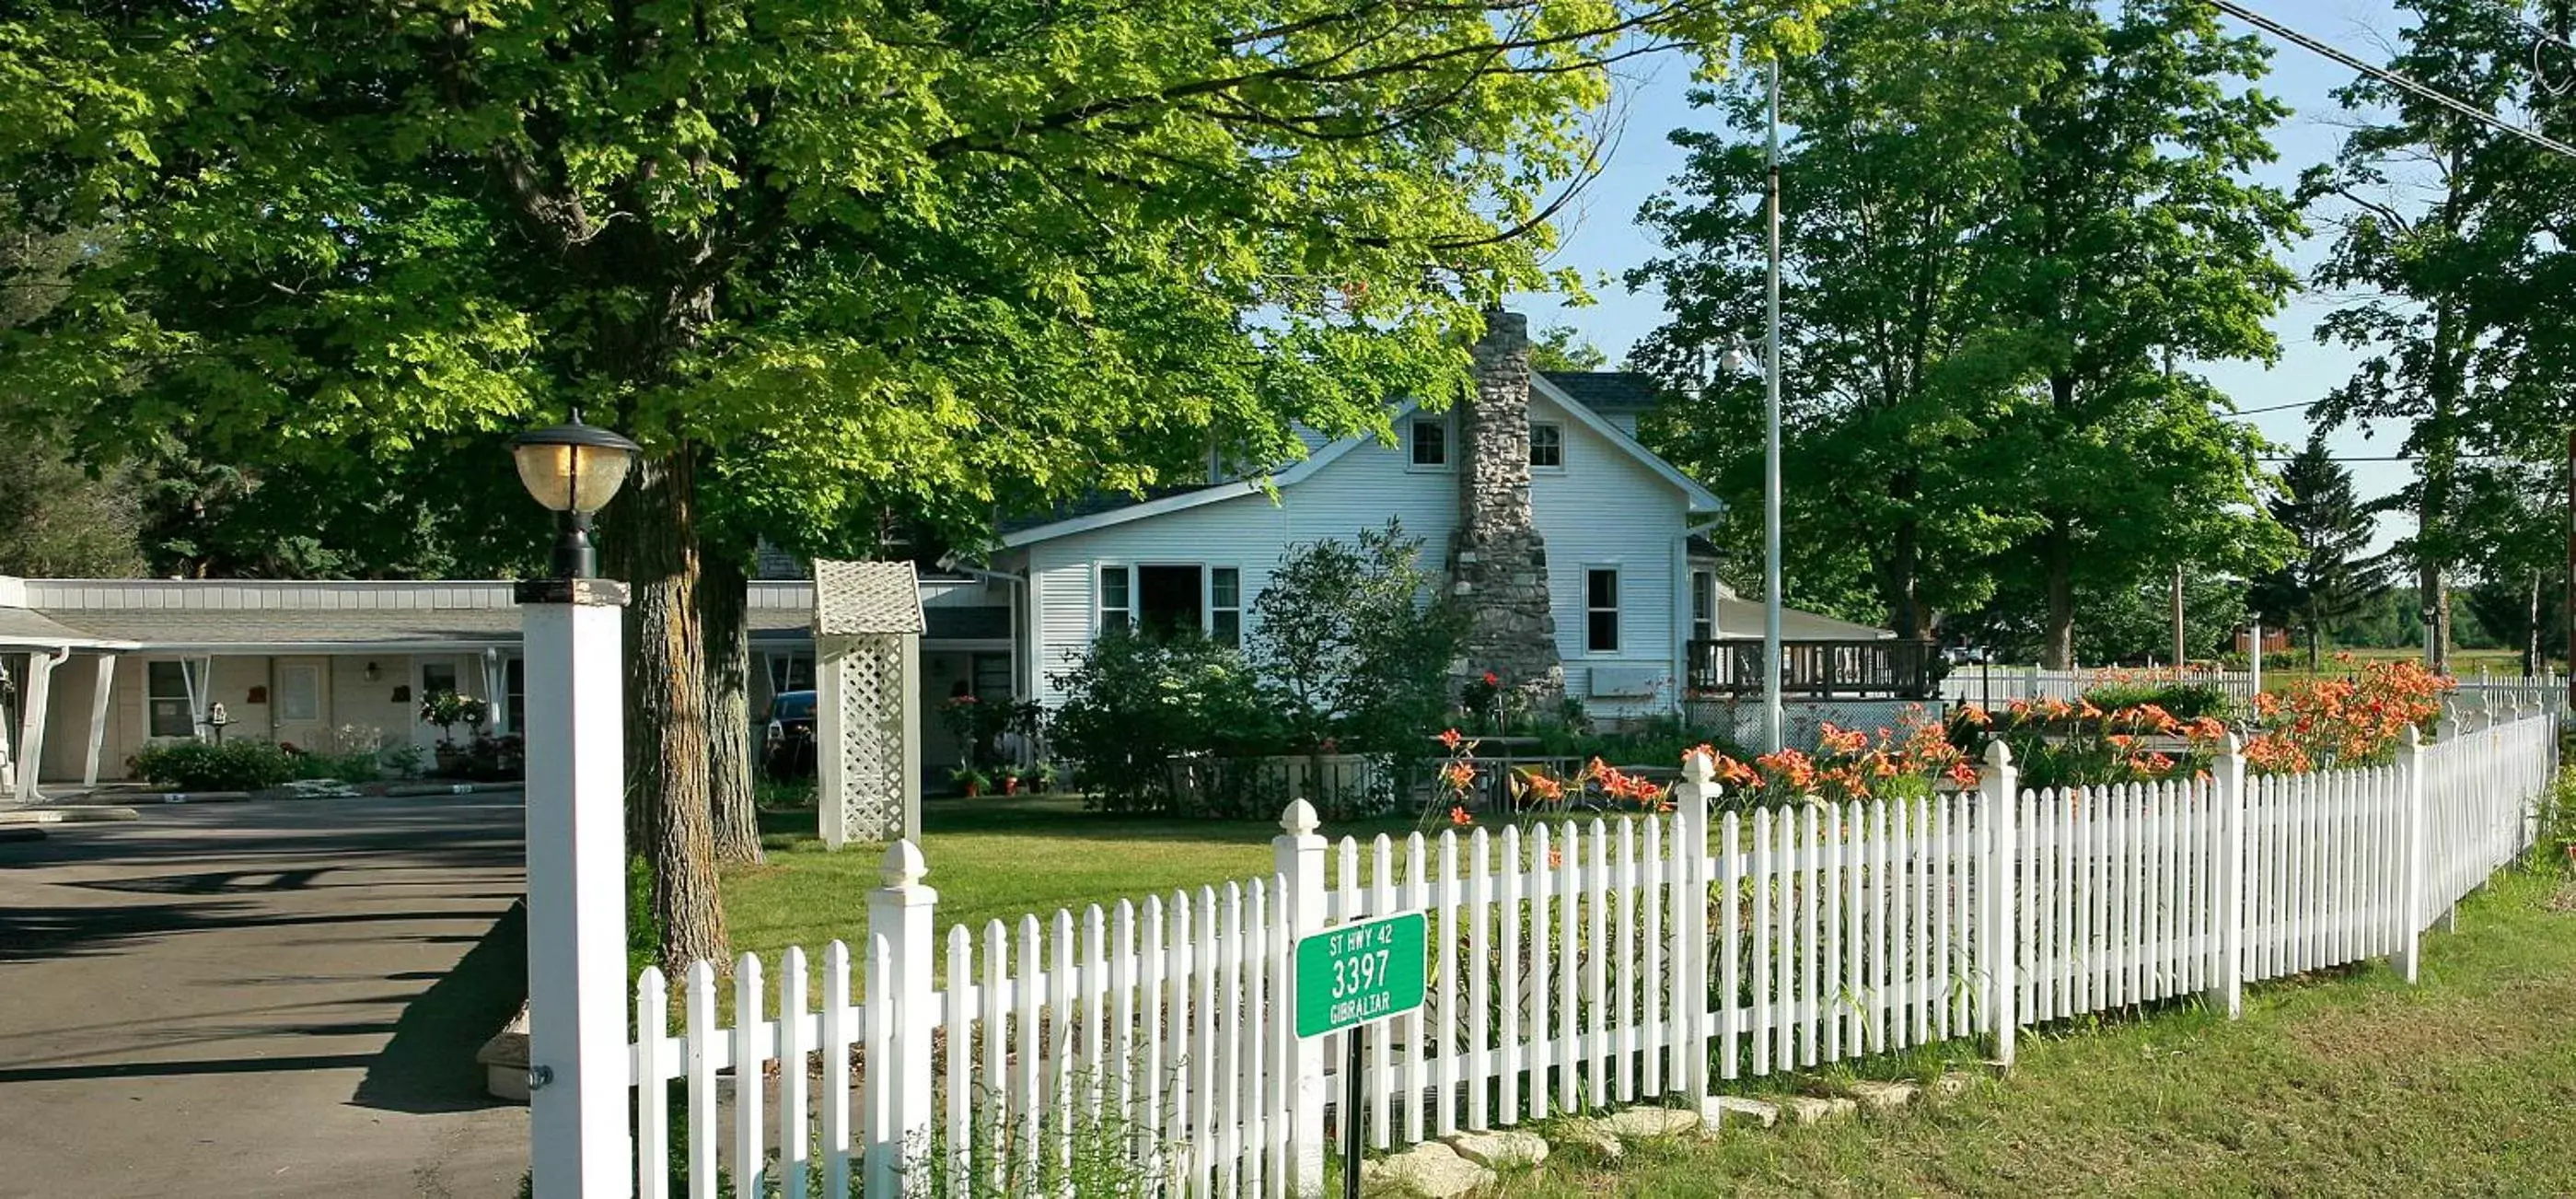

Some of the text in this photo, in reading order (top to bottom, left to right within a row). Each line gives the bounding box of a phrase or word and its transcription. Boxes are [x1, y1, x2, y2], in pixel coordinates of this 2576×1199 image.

[1329, 924, 1392, 957] ST HWY 42
[1332, 949, 1389, 998] 3397
[1330, 991, 1391, 1024] GIBRALTAR
